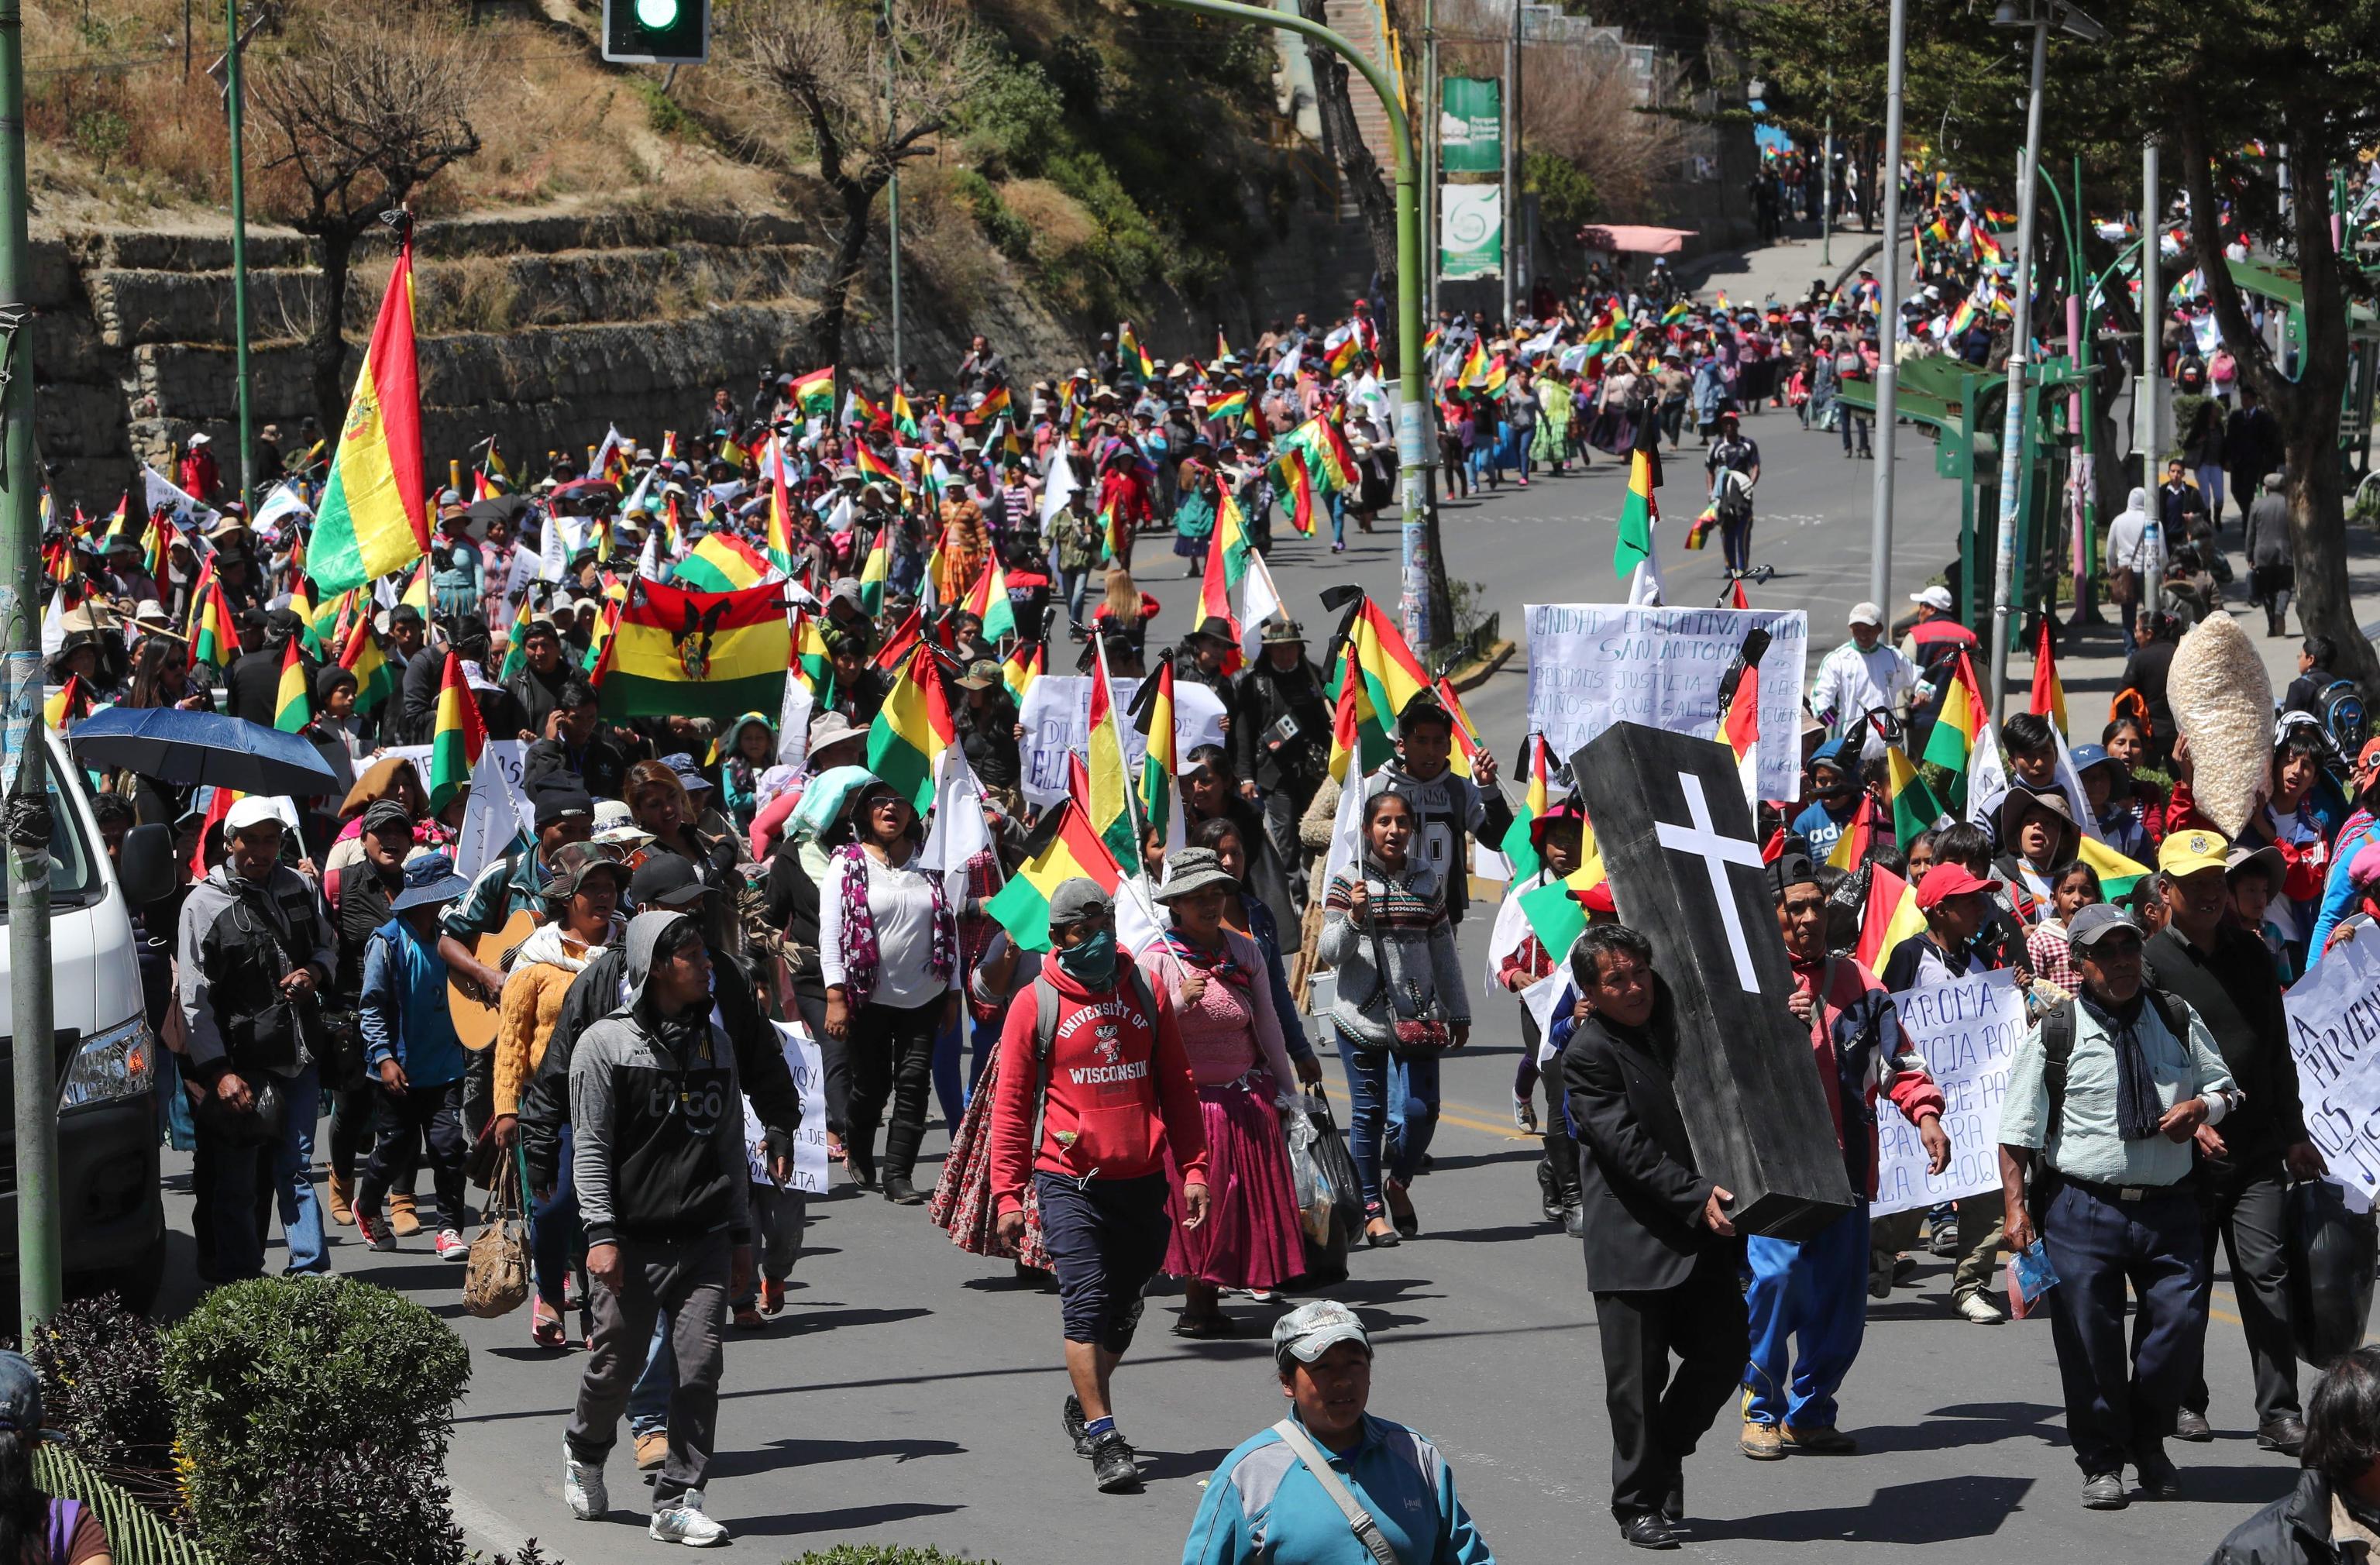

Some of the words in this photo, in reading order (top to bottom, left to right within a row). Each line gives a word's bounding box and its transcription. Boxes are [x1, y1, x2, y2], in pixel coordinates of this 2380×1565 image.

[1596, 638, 1651, 662] SAN
[1057, 1003, 1130, 1039] UNIVERSITY
[1132, 1013, 1148, 1030] OF
[1901, 982, 1998, 1030] AROMA
[1919, 1033, 1977, 1075] ICIA
[1069, 1060, 1147, 1085] WISCONSIN
[808, 1128, 825, 1147] DE
[1924, 1147, 2001, 1195] CHOQ
